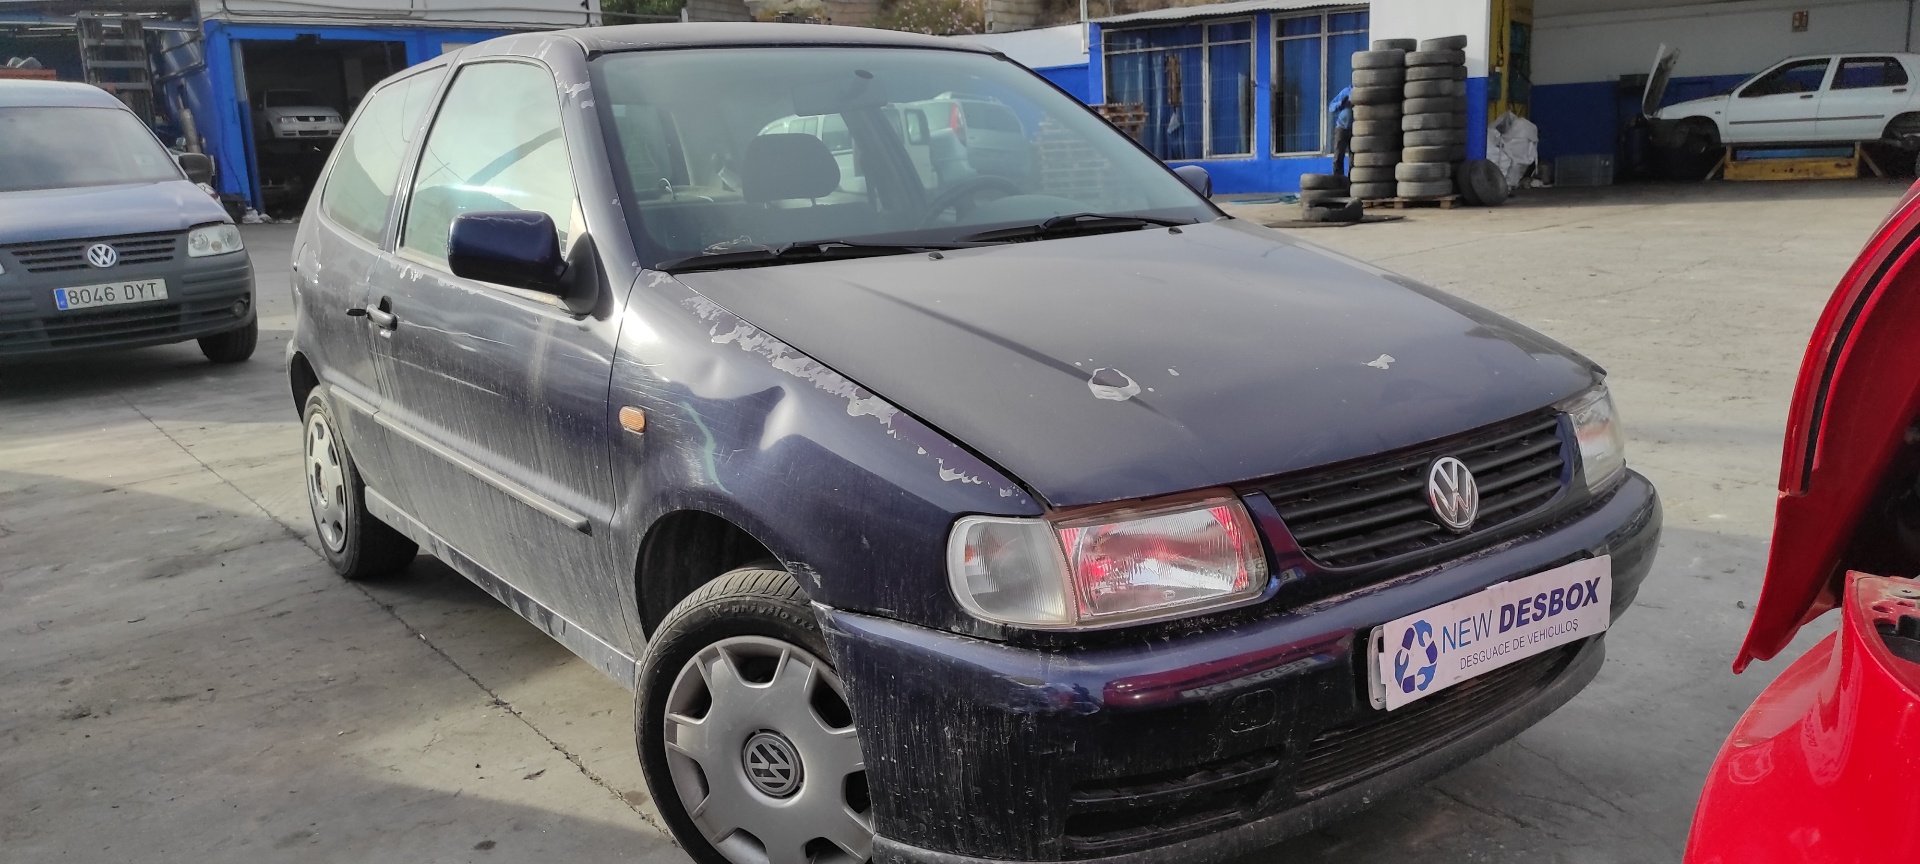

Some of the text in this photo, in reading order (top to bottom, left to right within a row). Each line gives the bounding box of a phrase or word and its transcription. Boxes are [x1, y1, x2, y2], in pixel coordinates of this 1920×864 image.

[68, 282, 157, 305] 8046 DYT
[1442, 576, 1601, 654] NEW DESBOX
[1460, 618, 1579, 670] DESGUACE DE VEHICULOS
